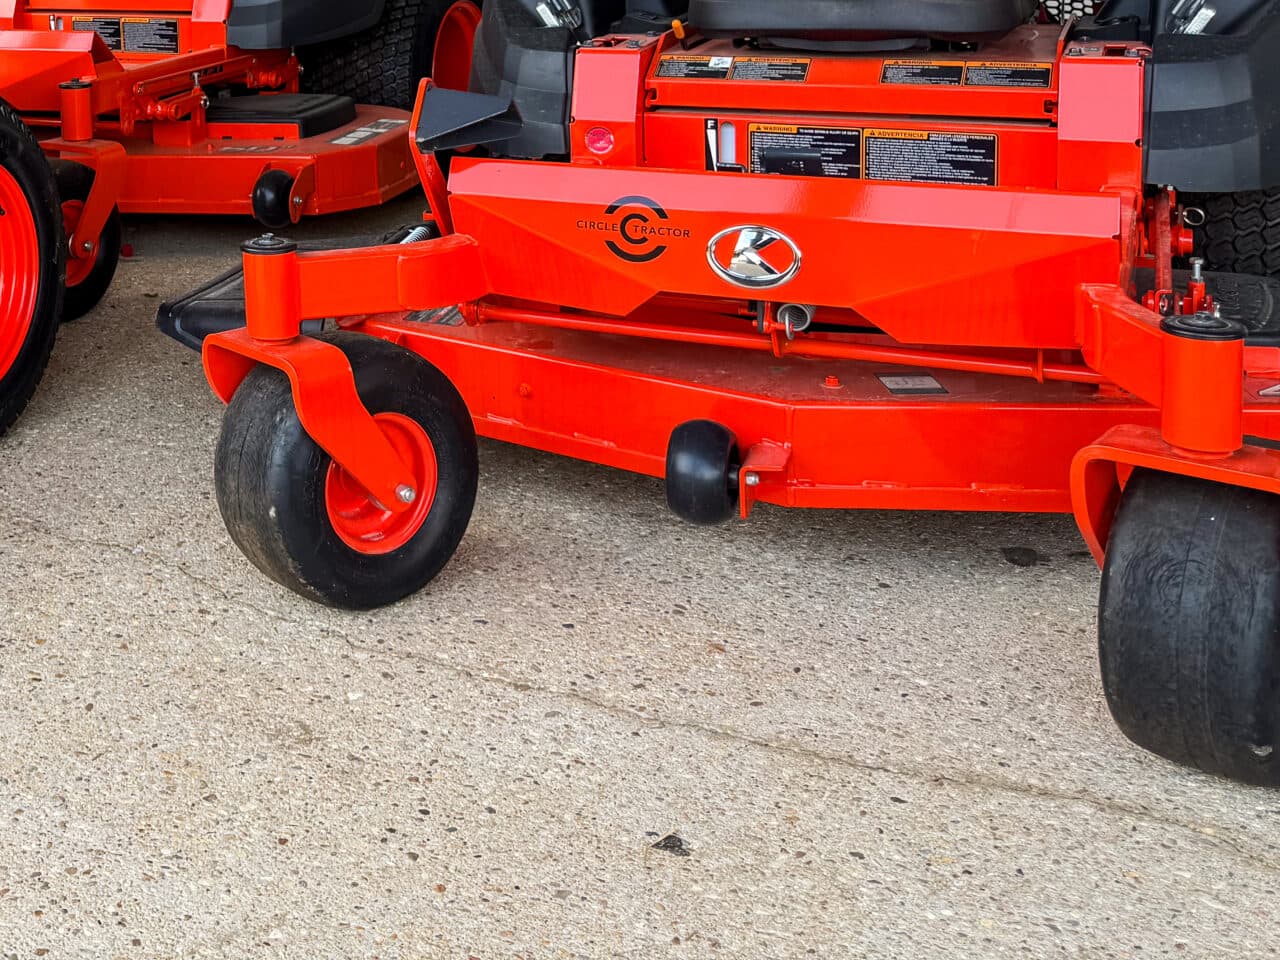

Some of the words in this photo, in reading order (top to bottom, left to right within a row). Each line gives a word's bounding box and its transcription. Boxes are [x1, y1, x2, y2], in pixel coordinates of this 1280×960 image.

[707, 119, 716, 129] F
[576, 220, 619, 232] CIRCLE
[632, 224, 691, 238] TRACTOR
